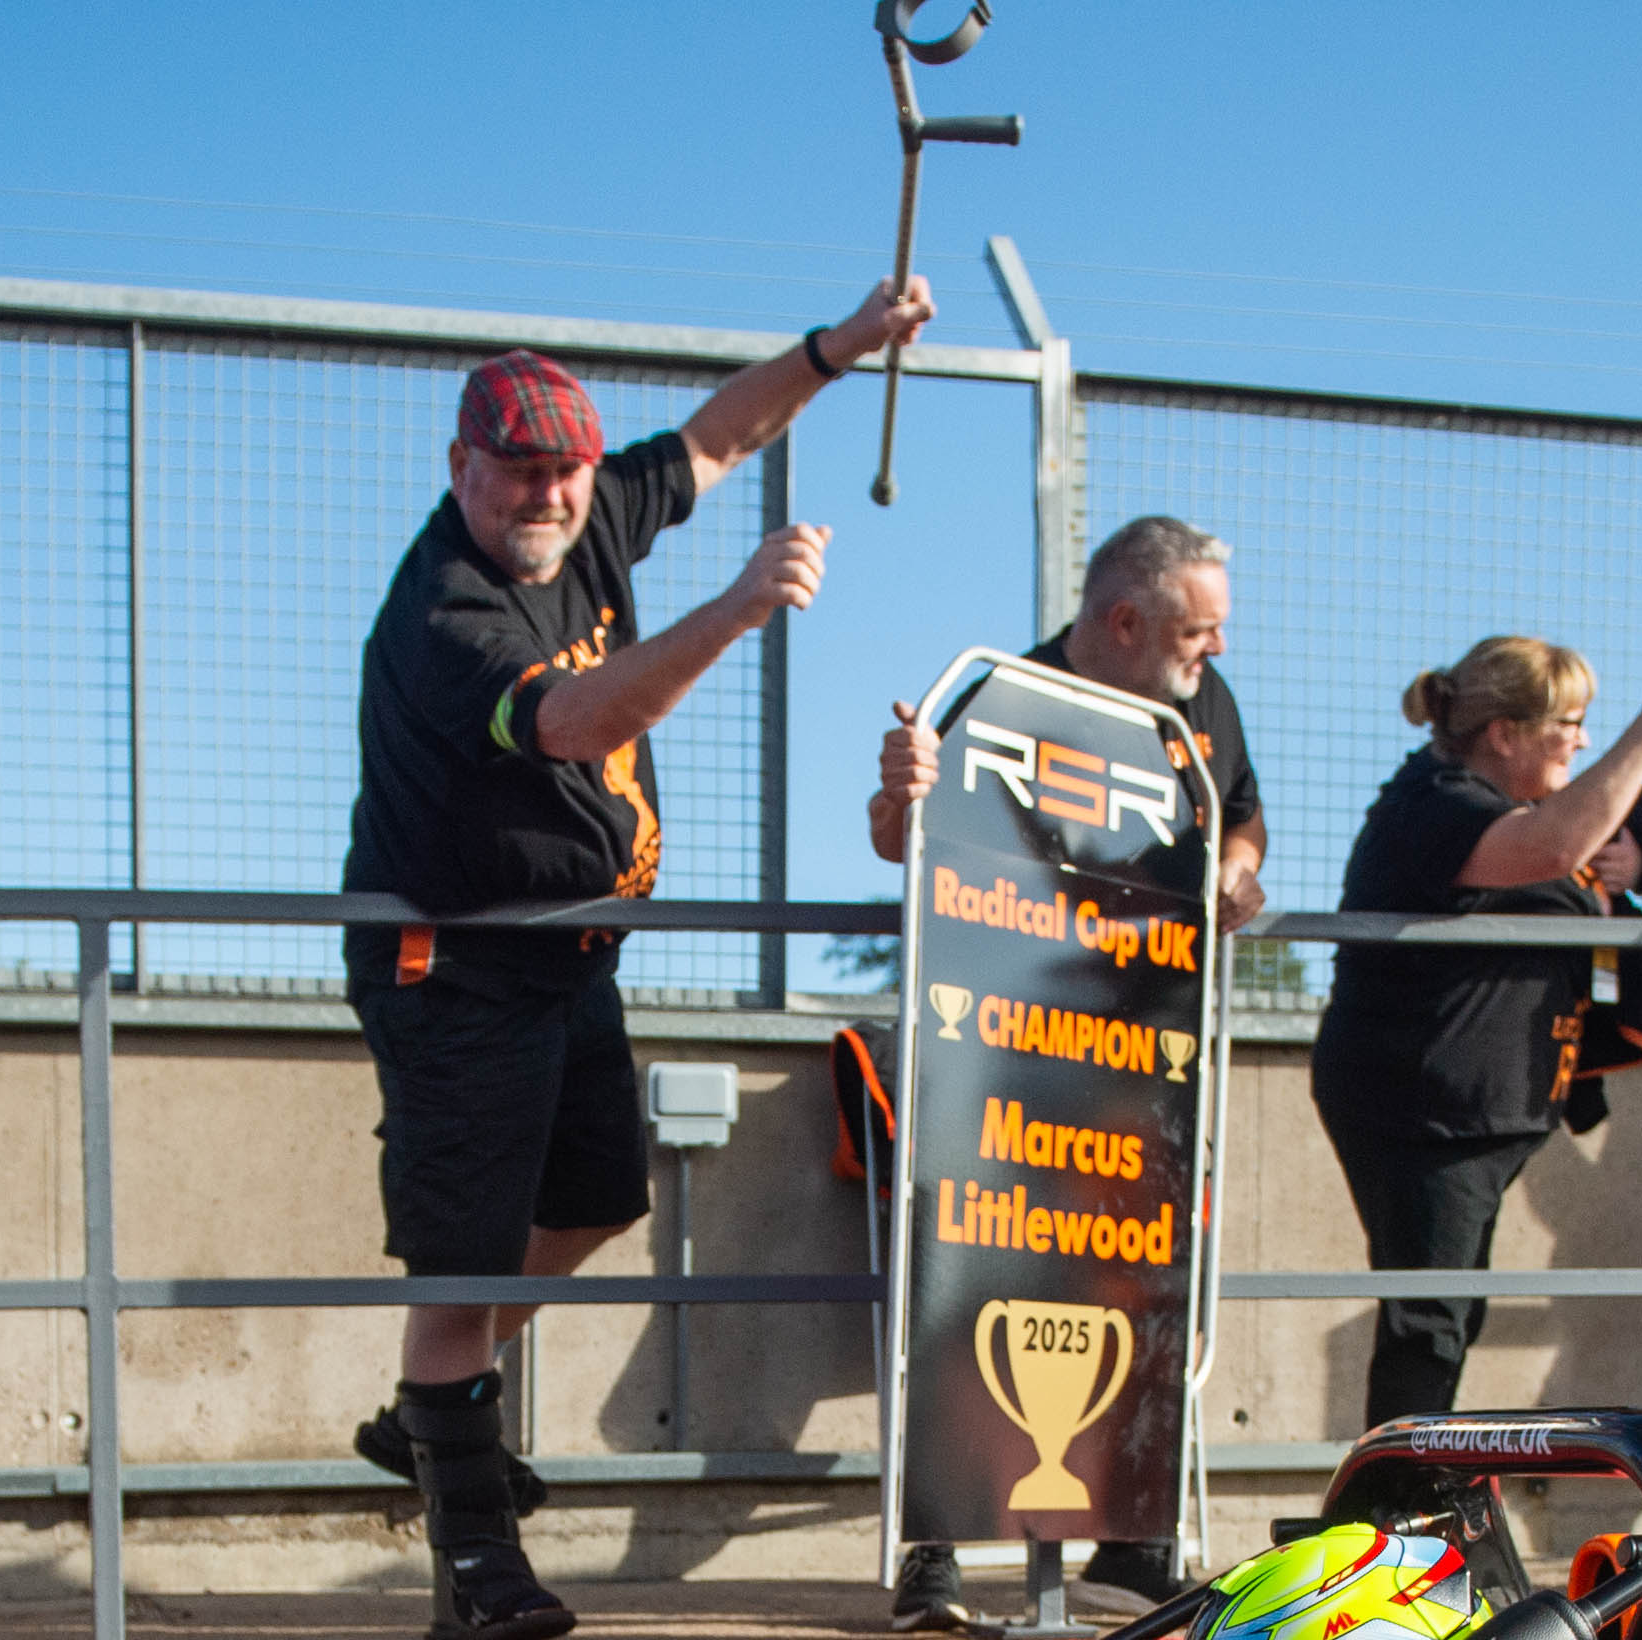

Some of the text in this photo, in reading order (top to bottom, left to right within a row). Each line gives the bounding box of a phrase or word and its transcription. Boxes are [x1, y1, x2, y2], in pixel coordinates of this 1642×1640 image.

[964, 719, 1176, 847] RSR
[933, 866, 1198, 973] Radical Cup UK
[977, 995, 1157, 1075] CHAMPION
[979, 1097, 1144, 1180] Marcus
[937, 1178, 1173, 1265] Littlewood
[1022, 1317, 1091, 1355] 2025
[1322, 1611, 1360, 1640] ML
